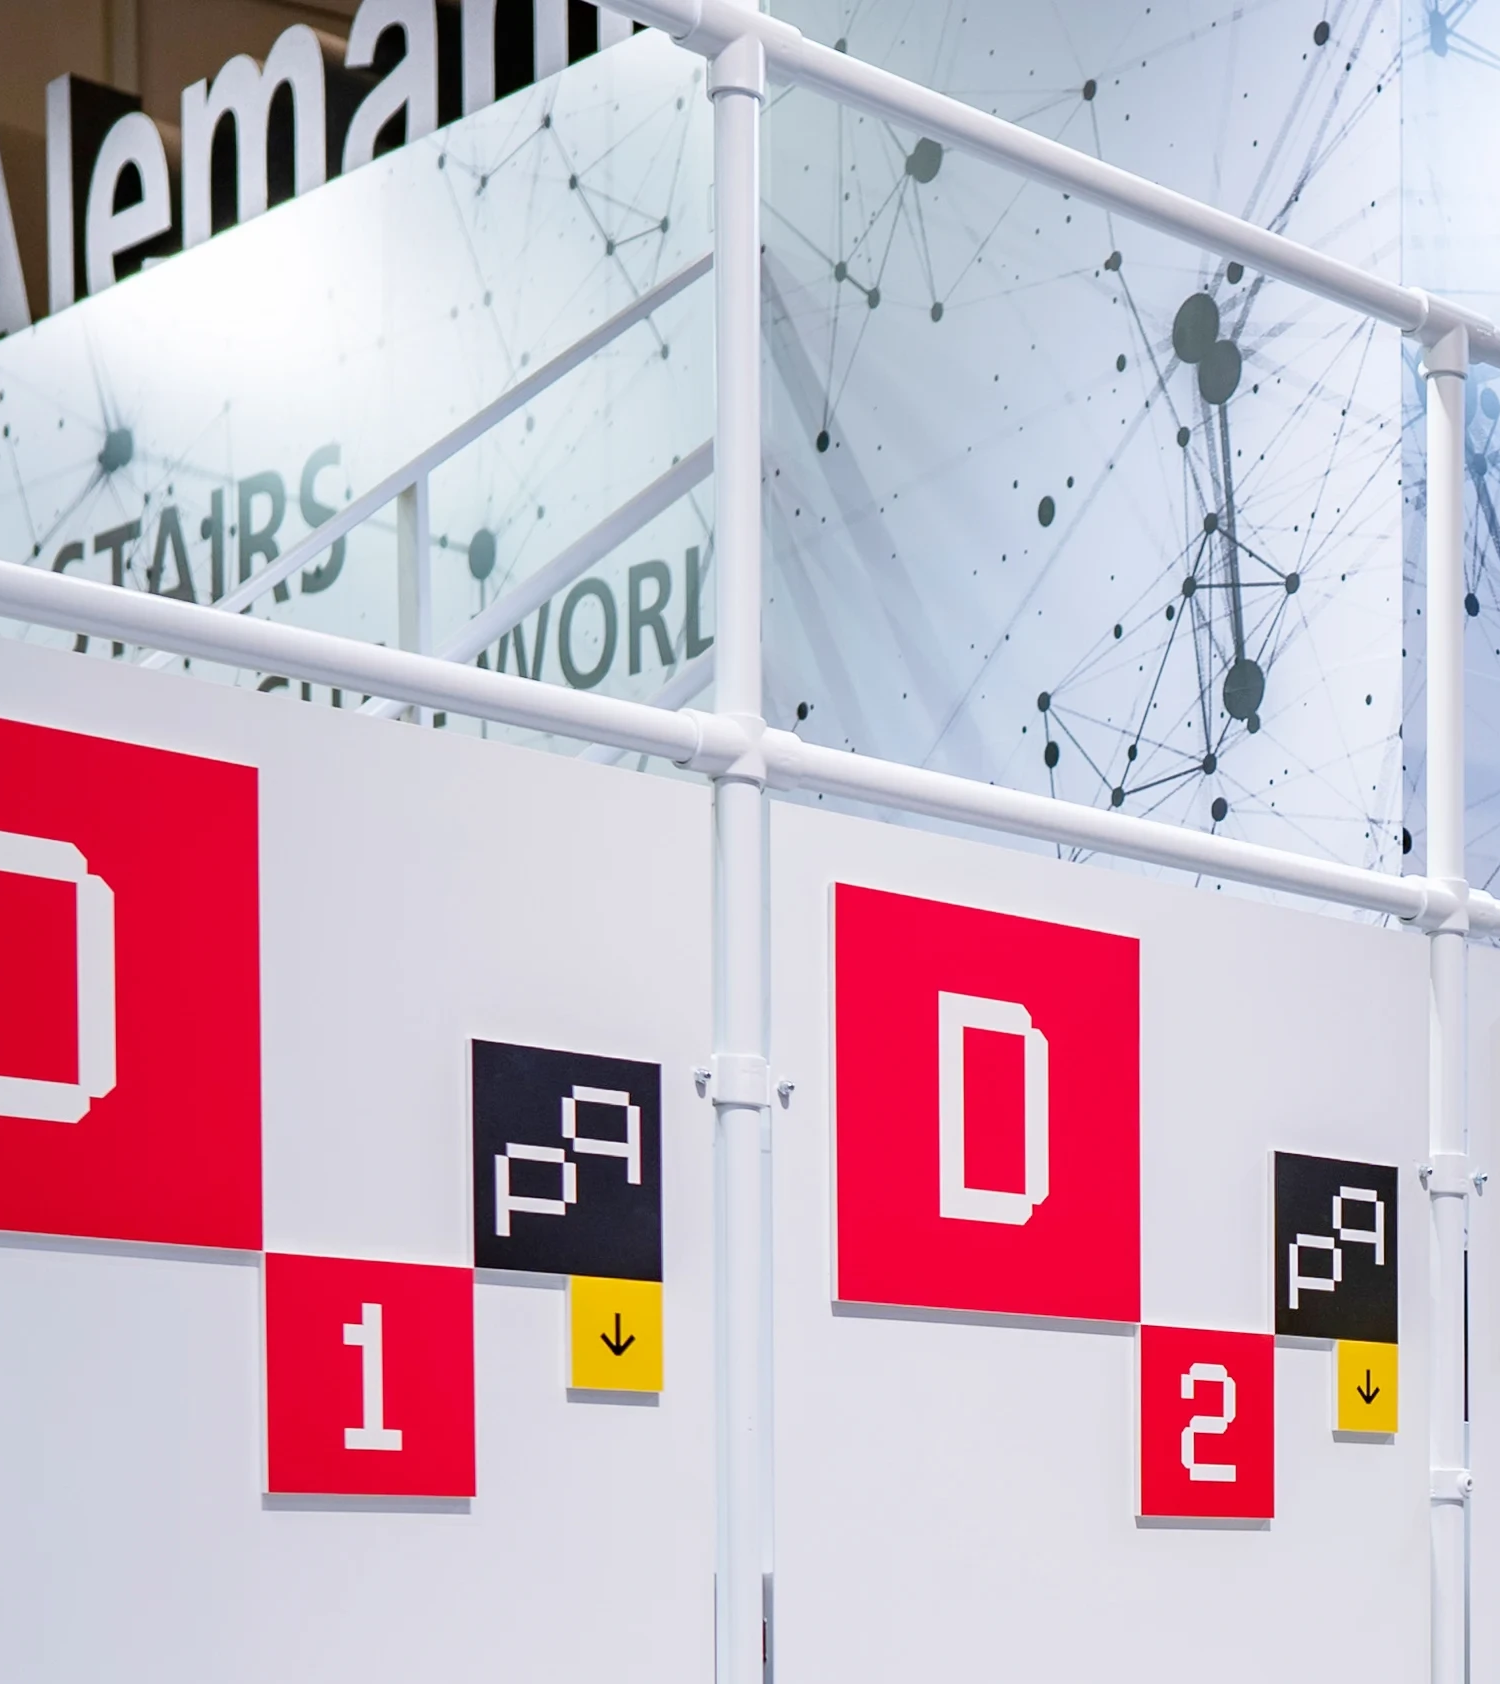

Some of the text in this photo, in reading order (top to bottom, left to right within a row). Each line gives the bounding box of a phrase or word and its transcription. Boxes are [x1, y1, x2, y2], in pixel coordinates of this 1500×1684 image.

[494, 1084, 641, 1237] pq
[938, 990, 1049, 1226] D
[1289, 1185, 1384, 1309] pq
[343, 1302, 403, 1451] 1
[1181, 1362, 1237, 1482] 2
